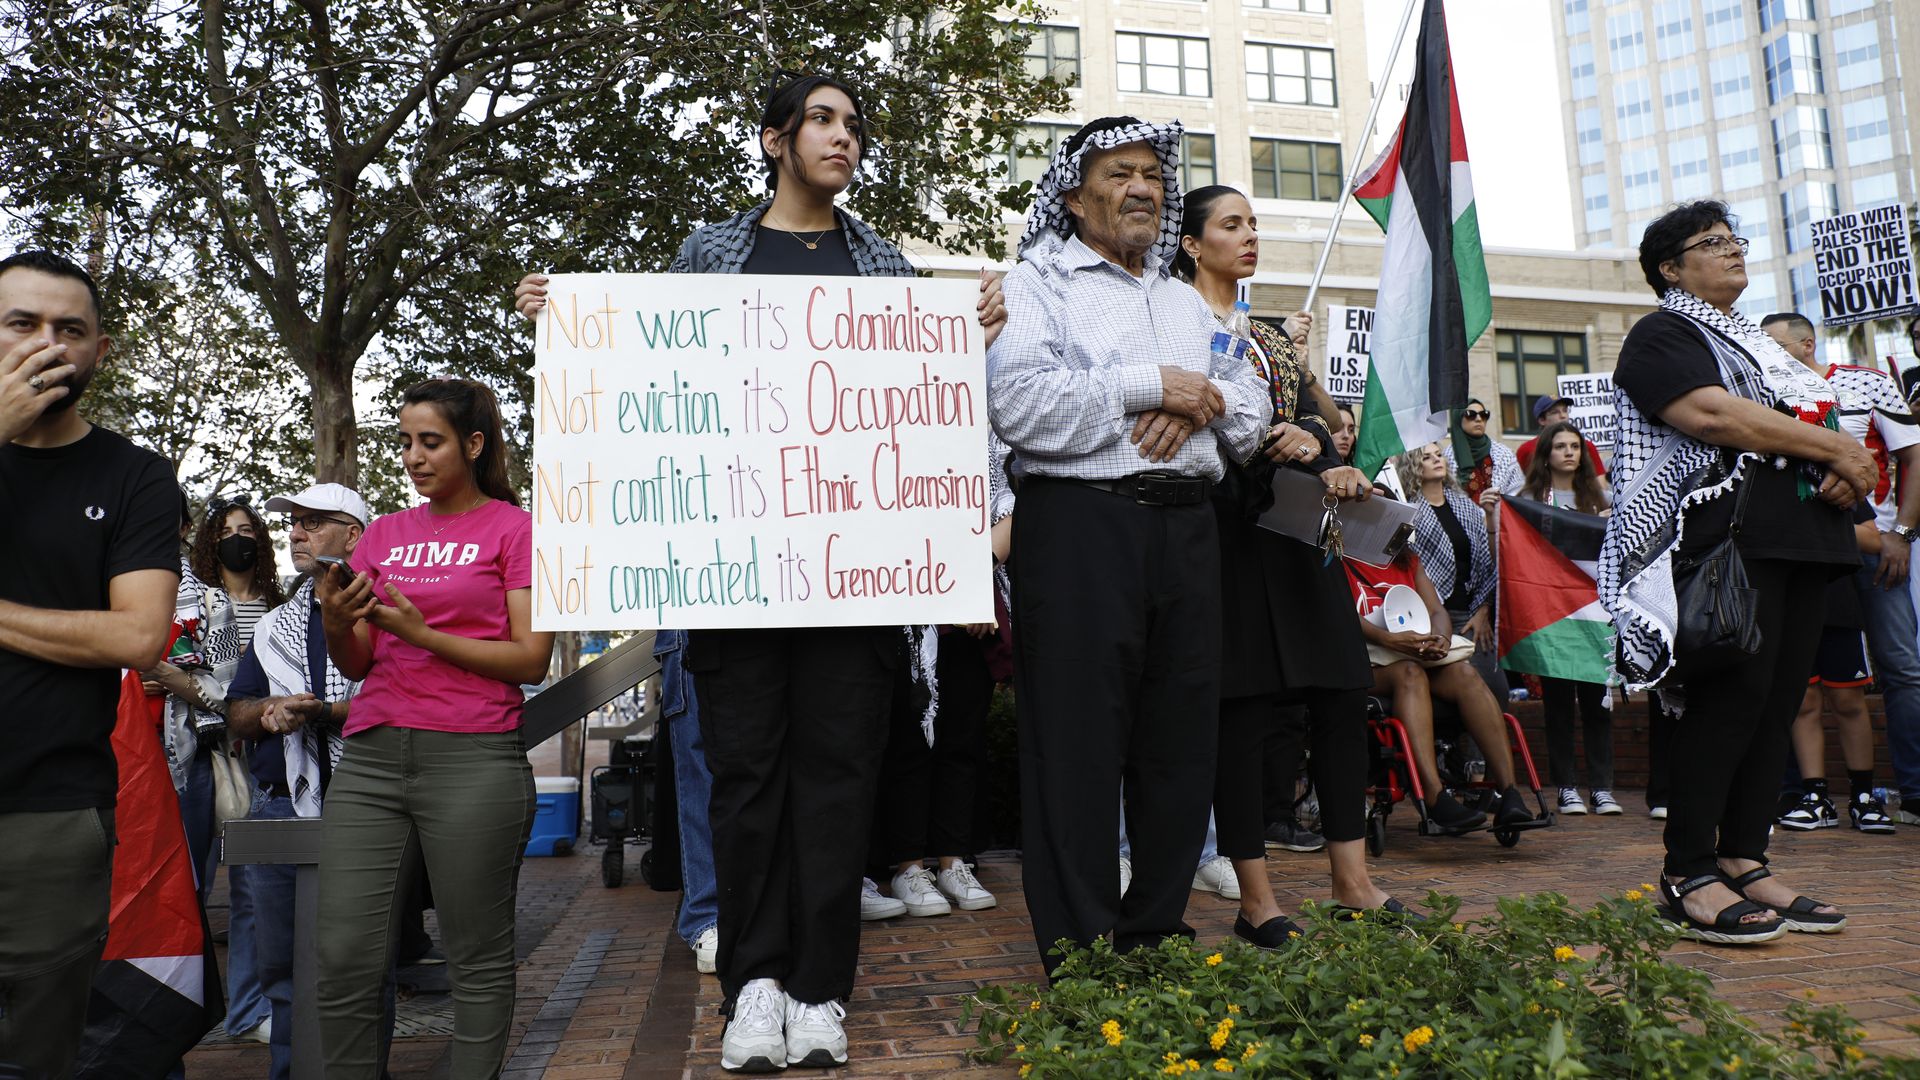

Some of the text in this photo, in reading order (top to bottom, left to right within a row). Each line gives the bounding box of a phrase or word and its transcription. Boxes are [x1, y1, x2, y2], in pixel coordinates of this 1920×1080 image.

[1811, 204, 1901, 237] STAND WITH
[1812, 221, 1904, 252] PALESTINE!
[1815, 236, 1908, 274] END THE
[1818, 259, 1911, 289] OCCUPATION
[1820, 273, 1913, 318] NOW!
[547, 286, 968, 357] Not war, it's Colonialism
[1330, 357, 1362, 377] U.S.
[1328, 378, 1343, 392] TO
[1562, 380, 1593, 396] FREE
[540, 360, 974, 452] Not eviction, it's Occupation
[537, 442, 986, 535] Not conflict, it's Ethnic Cleansing
[380, 541, 480, 567] PUMA
[388, 573, 416, 583] SINCE
[537, 533, 956, 625] Not complicated, it's Genocide
